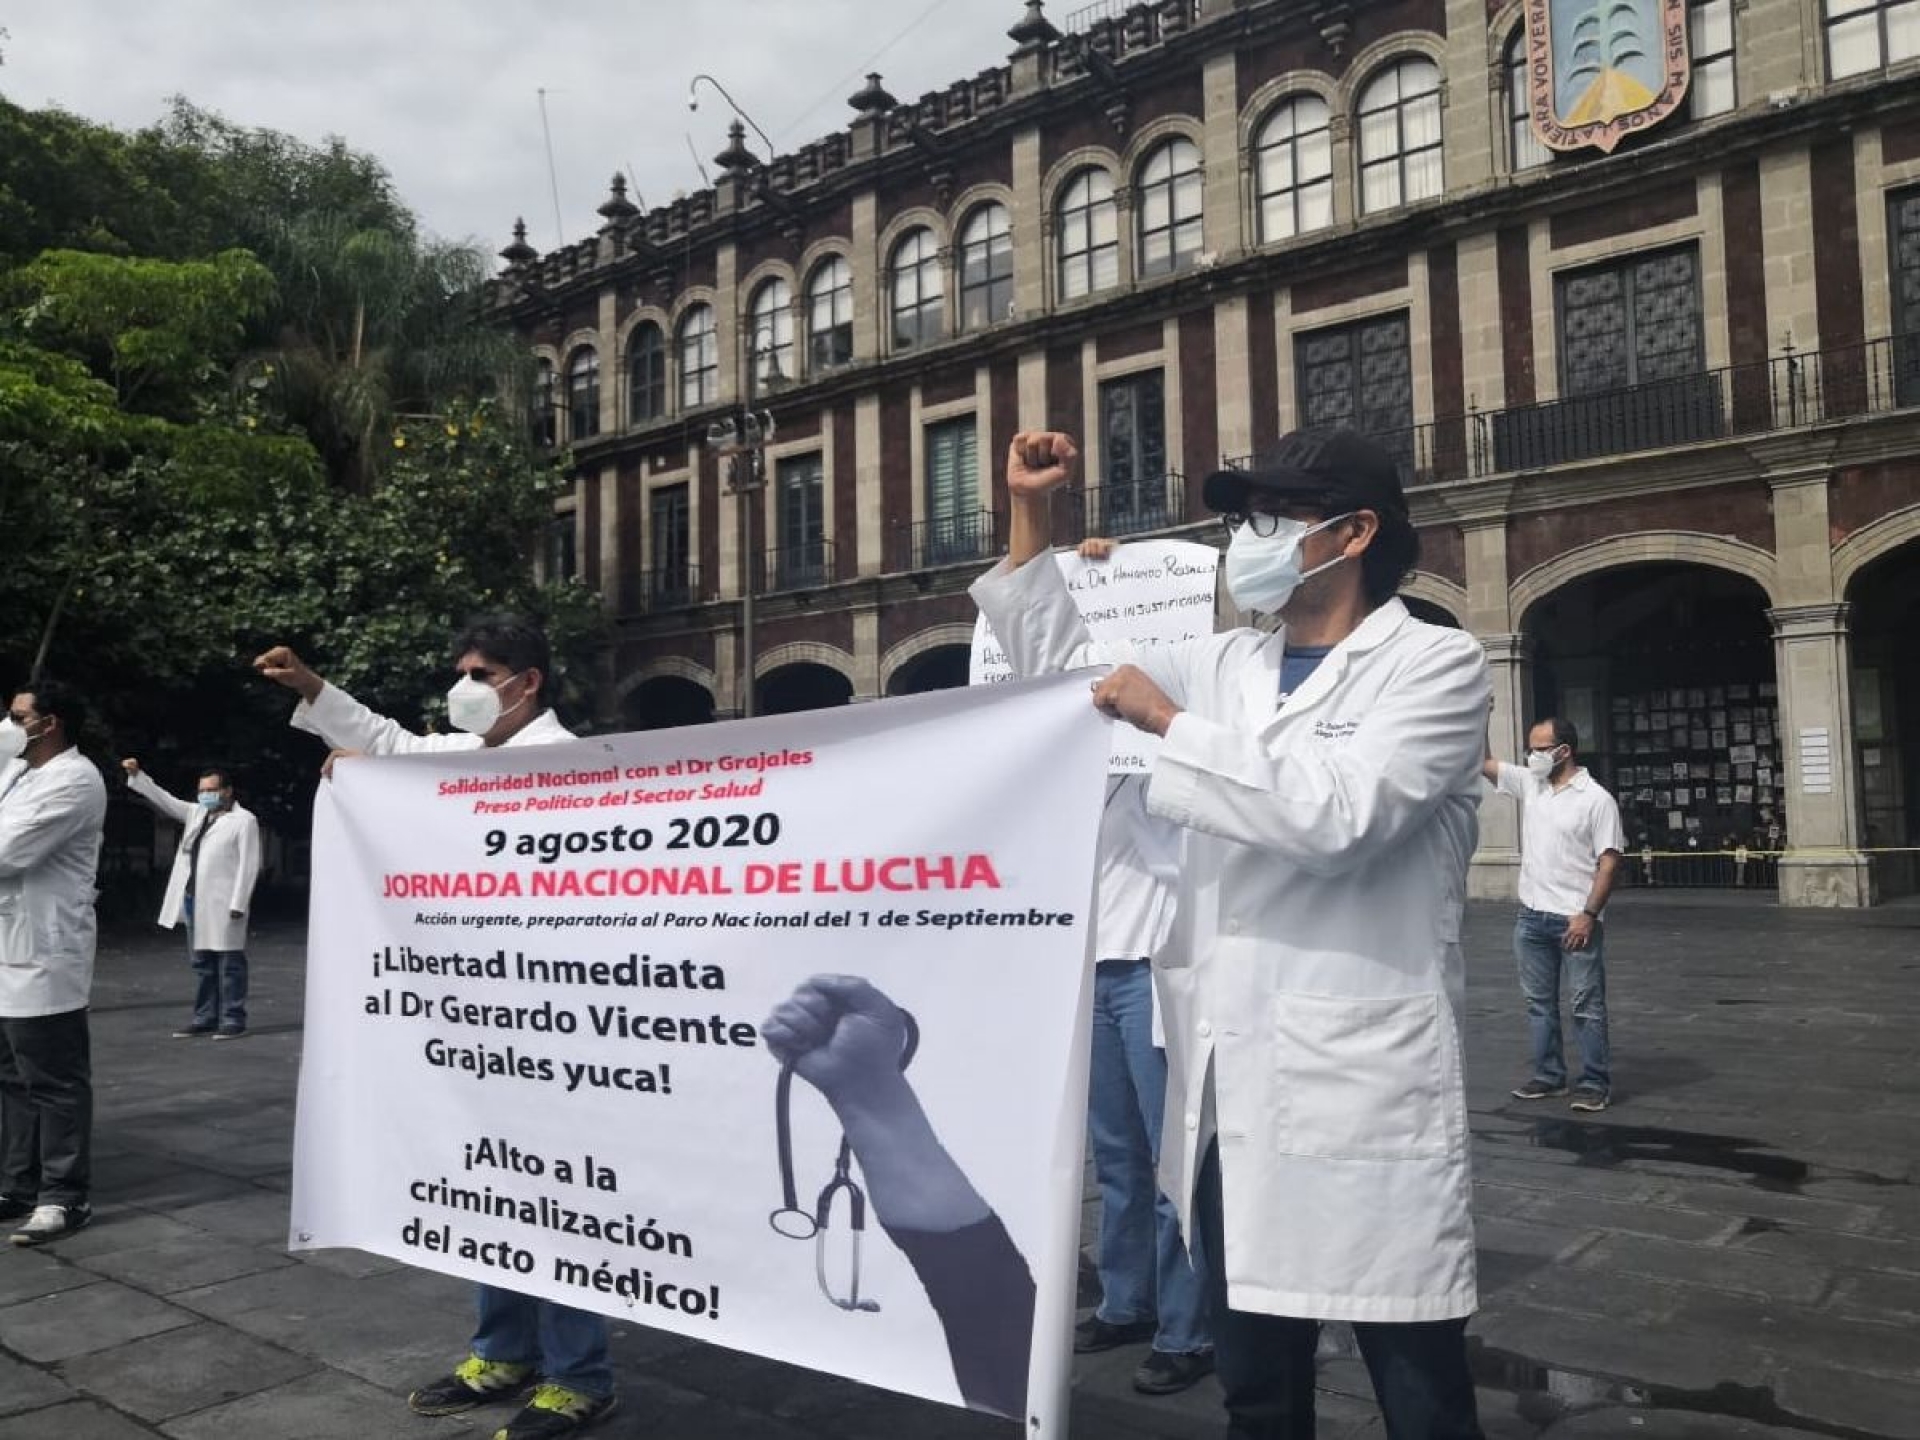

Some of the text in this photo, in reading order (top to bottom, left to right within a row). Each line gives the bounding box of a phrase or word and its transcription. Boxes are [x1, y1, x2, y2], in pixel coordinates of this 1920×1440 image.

[1534, 92, 1580, 146] TIERRA
[438, 772, 533, 796] Solidaridad
[624, 764, 660, 780] con
[664, 759, 683, 776] el
[686, 759, 714, 774] Dr
[715, 748, 813, 773] Grajales
[473, 776, 764, 814] Preso Político del Sector Salud
[484, 812, 780, 865] 9 agosto 2020
[383, 855, 1001, 899] JORNADA NACIONAL DE LUCHA
[414, 911, 457, 926] Acción
[461, 914, 523, 929] urgente,
[525, 912, 638, 930] preparatoria
[641, 911, 660, 927] al
[663, 912, 708, 928] Paro
[813, 910, 852, 928] del
[858, 911, 870, 927] 1
[877, 909, 910, 927] de
[915, 908, 1074, 931] Septiembre
[373, 946, 726, 991] ¡Libertad Inmediata
[364, 988, 757, 1047] al Dr Gerardo Vicente
[424, 1038, 672, 1095] Grajales yuca!
[465, 1137, 617, 1193] ¡Alto a la
[409, 1177, 693, 1258] criminalización
[402, 1217, 720, 1321] del acto médico!
